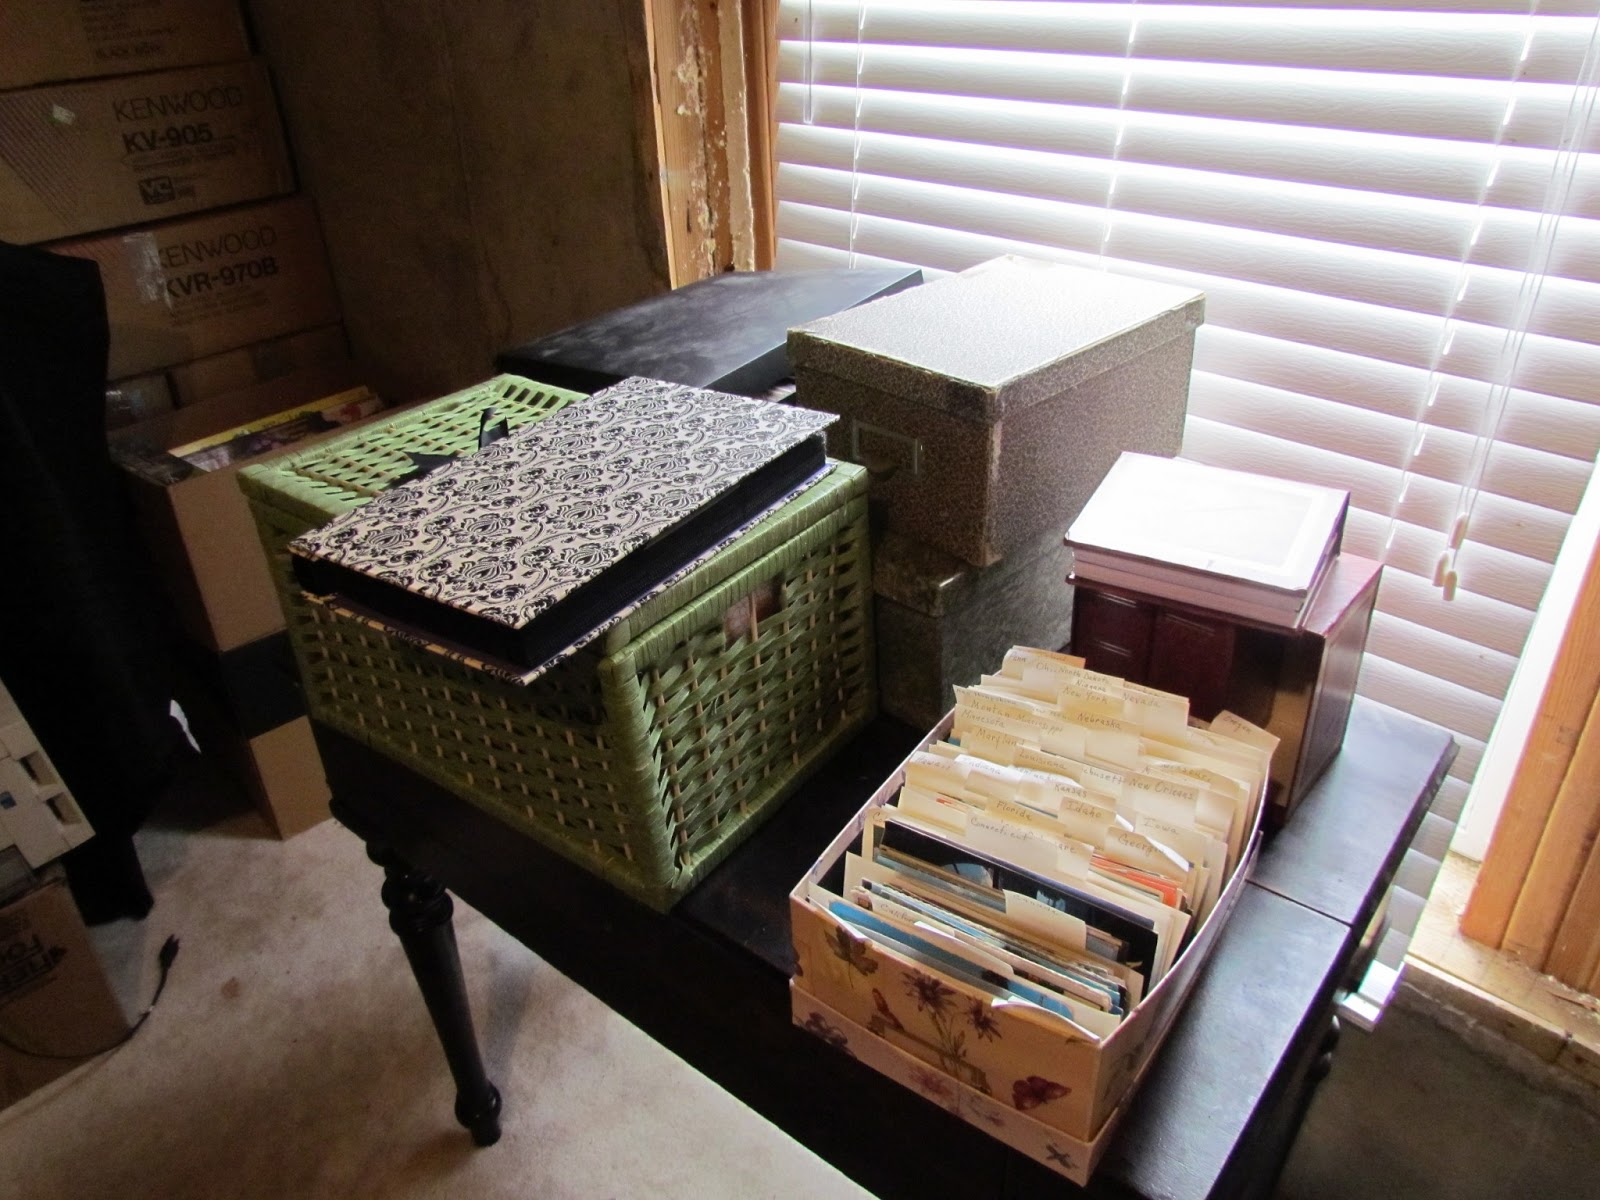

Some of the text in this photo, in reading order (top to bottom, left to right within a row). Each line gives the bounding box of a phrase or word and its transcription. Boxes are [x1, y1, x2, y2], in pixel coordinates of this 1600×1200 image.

[113, 86, 241, 122] KENWOOD
[122, 122, 213, 154] KV-905
[1077, 711, 1121, 730] Nebraska
[1054, 783, 1088, 798] Kansas
[1128, 778, 1194, 800] New Orleans
[1066, 799, 1102, 818] Idaho
[1144, 817, 1179, 834] Iowa
